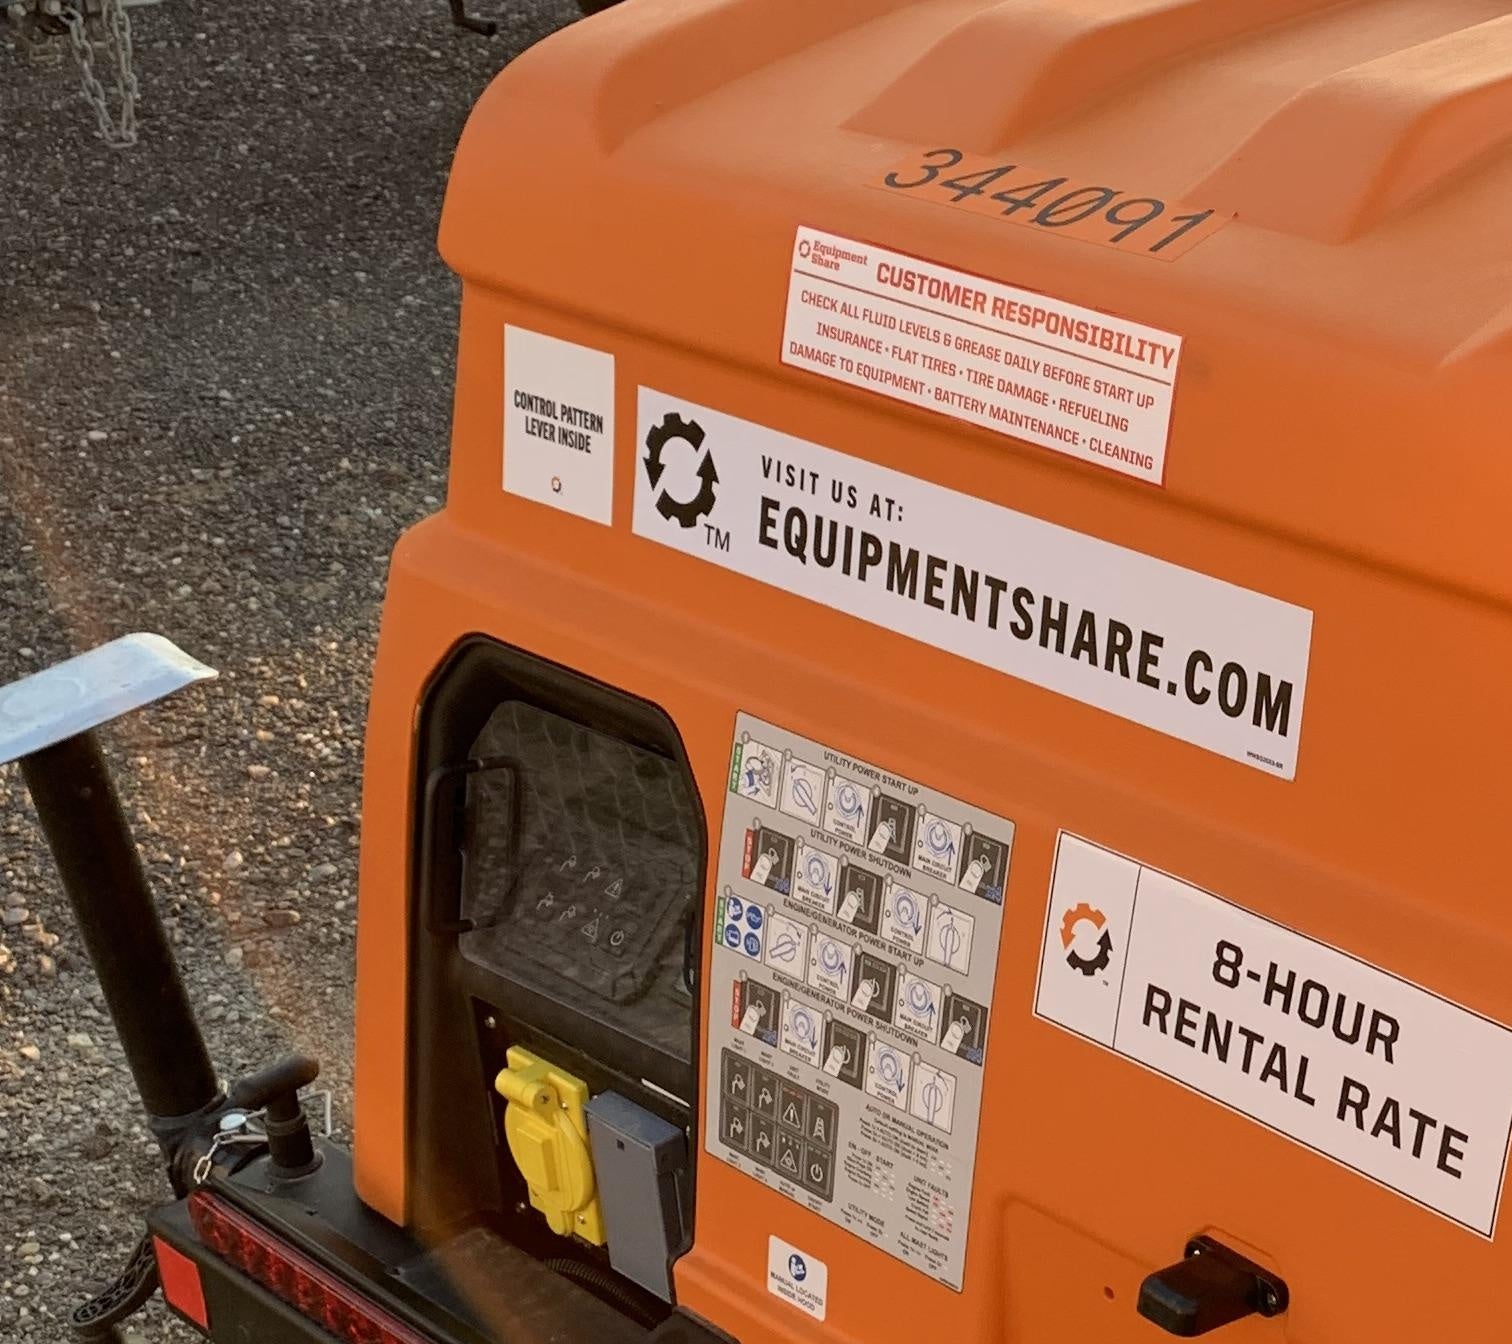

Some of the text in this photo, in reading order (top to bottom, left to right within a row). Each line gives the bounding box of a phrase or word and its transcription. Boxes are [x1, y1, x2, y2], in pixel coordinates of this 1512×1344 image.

[885, 148, 1215, 253] 344091
[811, 253, 841, 271] Share
[813, 240, 868, 266] Equipment
[876, 262, 1175, 369] CUSTOMER RESPONSIBILITY
[801, 290, 1155, 410] CHECK ALL FLUID LEVELS & GREASE DAILY BEFORE START UP
[816, 322, 1129, 433] INSURANCE FLAT TIRES TIRE DAMAGE REFUELING
[513, 389, 604, 435] CONTROL PATTERN
[525, 415, 592, 455] LEVER INSIDE
[789, 341, 1153, 471] DAMAGE TO EQUIPMENT BATTERY MAINTENANCE CLEANING
[761, 454, 904, 523] VISIT US AT:
[703, 523, 731, 553] TM
[758, 494, 1294, 738] EQUIPMENTSHARE.COM
[823, 749, 918, 797] UTILITY POWER START UP
[809, 827, 912, 880] UTILITY POWER SHUTDOWN
[858, 929, 887, 952] POWER
[887, 943, 912, 963] START
[912, 955, 924, 969] UP
[847, 1006, 875, 1028] POWER
[874, 1019, 918, 1049] SHUTDOWN
[1212, 939, 1401, 1065] 8-HOUR
[1142, 983, 1469, 1180] RENTAL RATE
